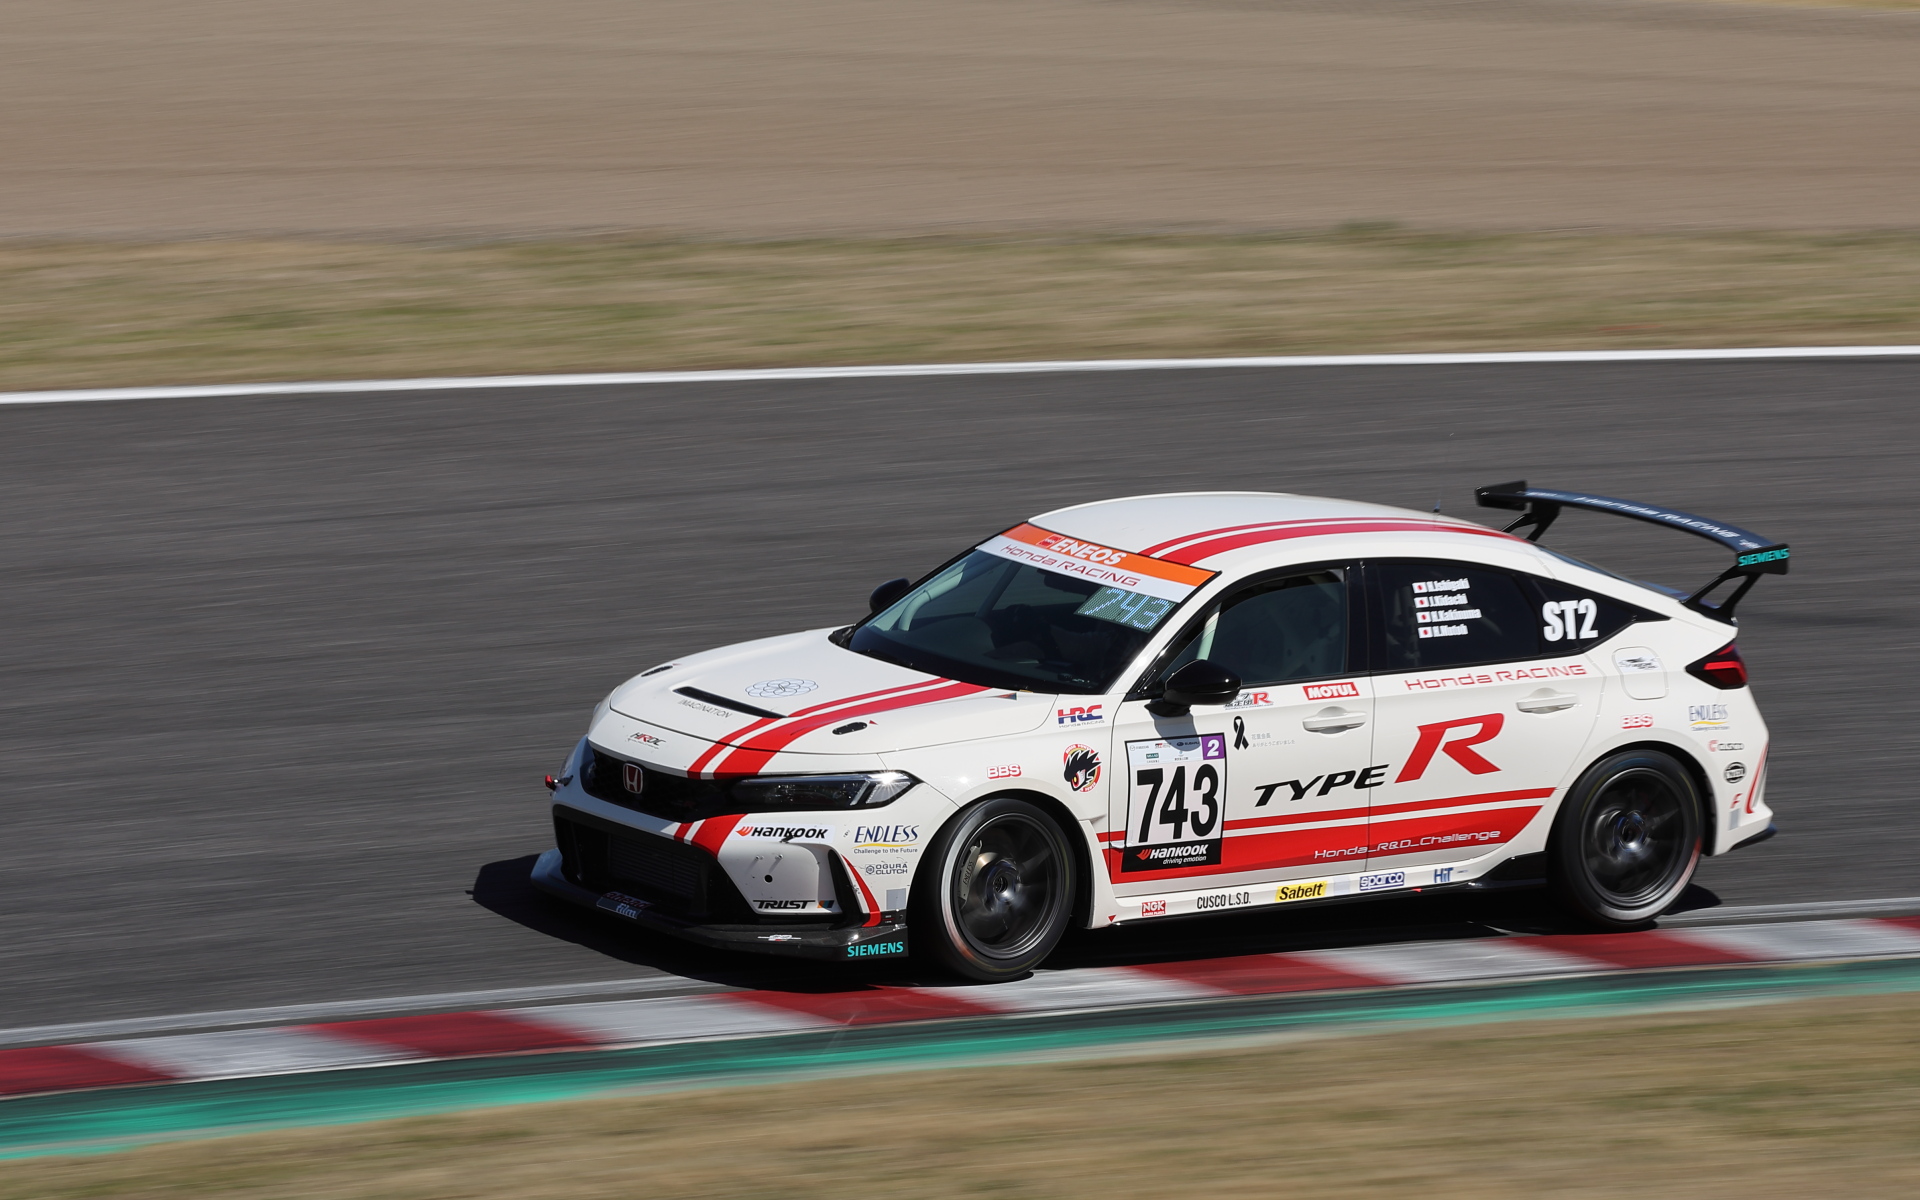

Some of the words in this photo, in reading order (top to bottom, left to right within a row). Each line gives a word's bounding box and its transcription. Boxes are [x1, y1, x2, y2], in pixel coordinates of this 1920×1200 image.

[1053, 538, 1127, 565] ENEOS
[1738, 548, 1789, 567] SIEMENS
[1000, 544, 1056, 567] Honda
[1056, 560, 1141, 587] RACING
[1084, 588, 1170, 629] 743
[1542, 599, 1598, 641] ST2
[1405, 672, 1492, 690] Honda
[1496, 664, 1587, 682] RACING
[1308, 684, 1356, 699] MOTUL
[678, 699, 733, 718] IMAGINATION
[1058, 704, 1102, 724] HRC
[1621, 714, 1653, 729] BBS
[1206, 739, 1219, 757] 2
[1254, 764, 1389, 807] TYPE
[1394, 712, 1504, 783] R
[987, 764, 1021, 779] BBS
[1137, 764, 1219, 843] 743
[854, 825, 920, 843] ENDLESS
[962, 861, 973, 885] ENDLESS
[1360, 873, 1404, 888] sparco
[1279, 882, 1323, 900] Sabelt
[753, 900, 815, 910] TRUST
[1143, 900, 1165, 912] NGK
[1197, 894, 1226, 909] CUSCO
[1228, 892, 1251, 906] L.S.D.
[615, 903, 637, 918] film
[847, 942, 904, 957] SIEMENS
